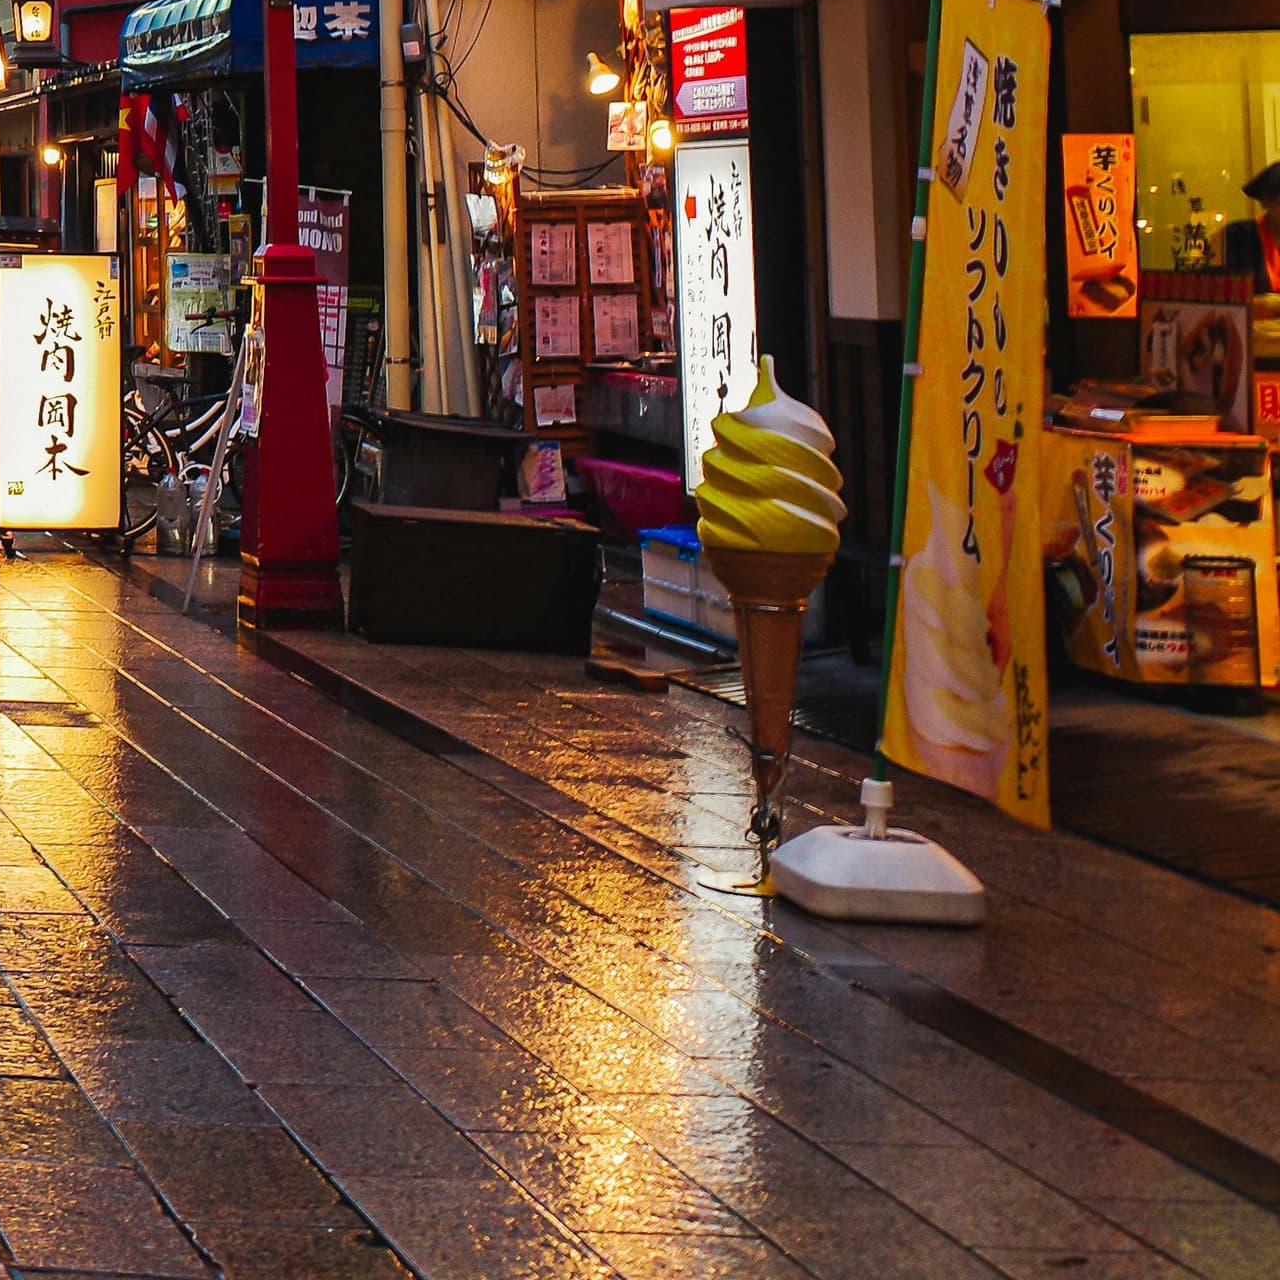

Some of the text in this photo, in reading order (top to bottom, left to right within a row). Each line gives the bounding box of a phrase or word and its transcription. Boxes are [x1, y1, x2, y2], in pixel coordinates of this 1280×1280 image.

[32, 297, 91, 480] 焼肉岡本
[93, 280, 116, 339] 江戸前
[961, 205, 988, 566] ソフトクリーム
